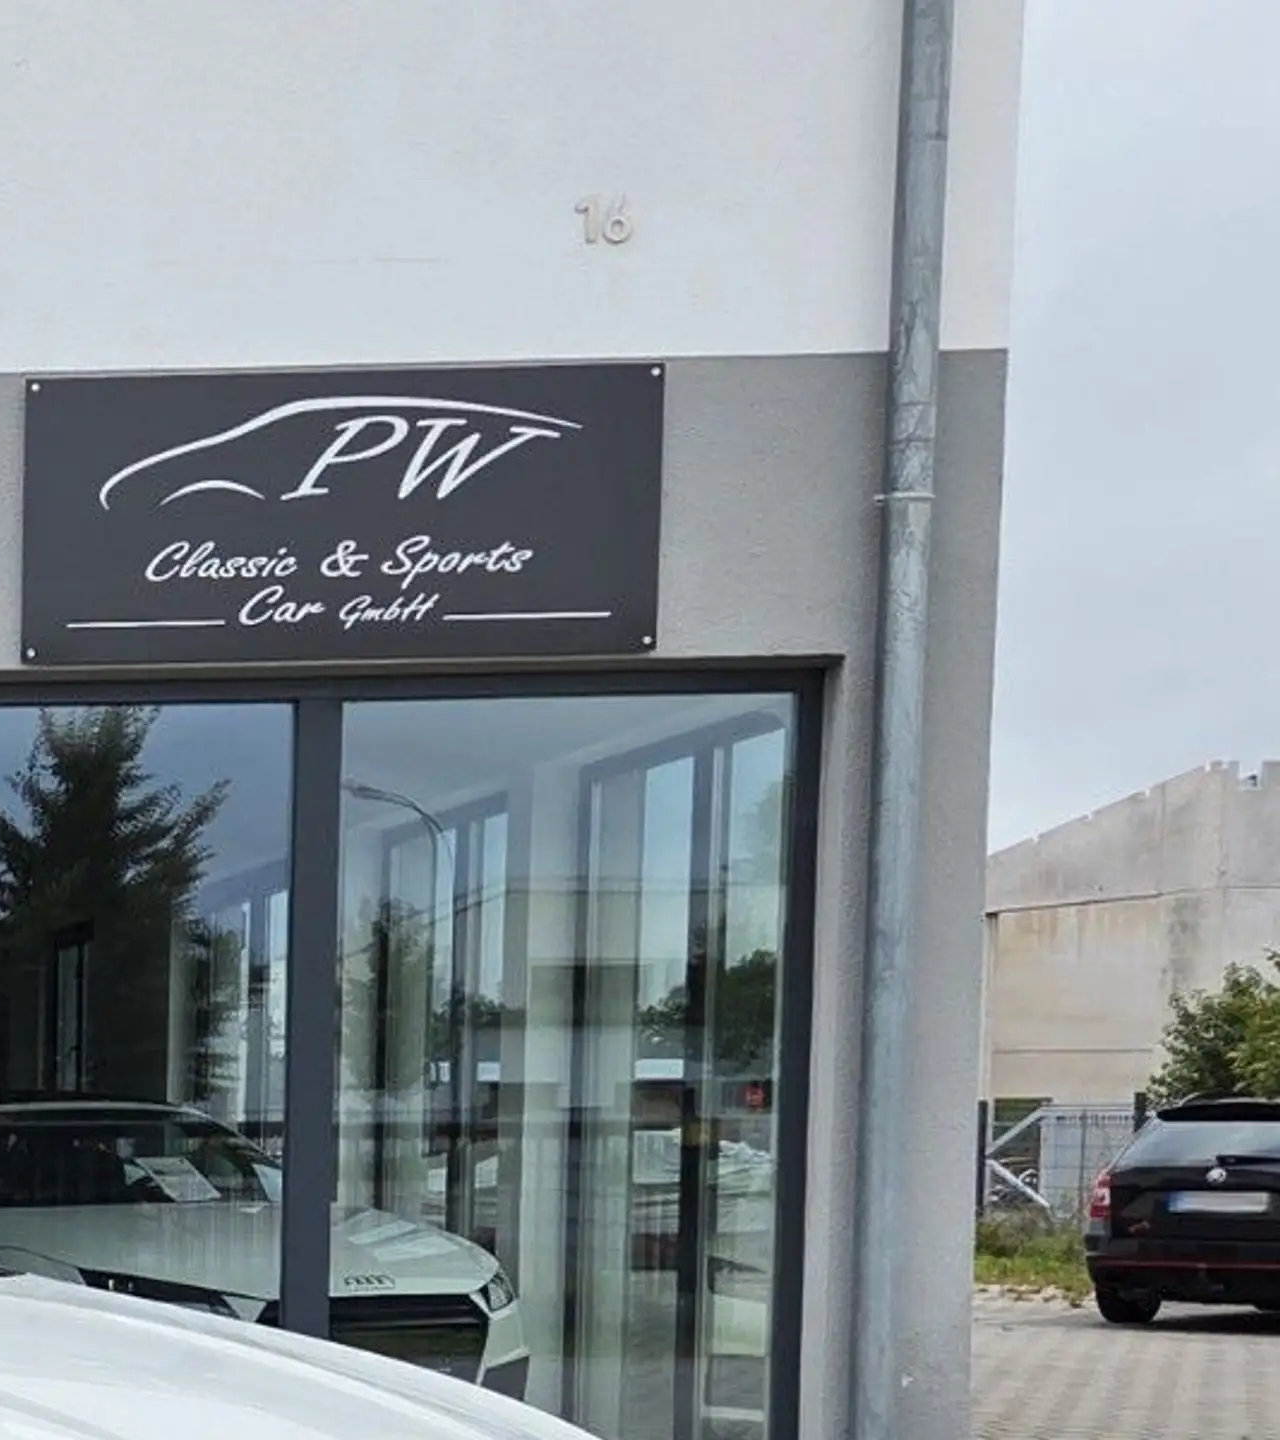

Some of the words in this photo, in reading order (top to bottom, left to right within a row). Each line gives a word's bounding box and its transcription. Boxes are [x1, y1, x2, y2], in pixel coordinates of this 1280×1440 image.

[573, 193, 633, 246] 16
[280, 415, 561, 501] PW
[144, 541, 298, 582] Classic
[320, 539, 370, 578] &
[380, 535, 533, 590] Sports
[238, 586, 326, 626] Car
[338, 592, 440, 630] GmbH
